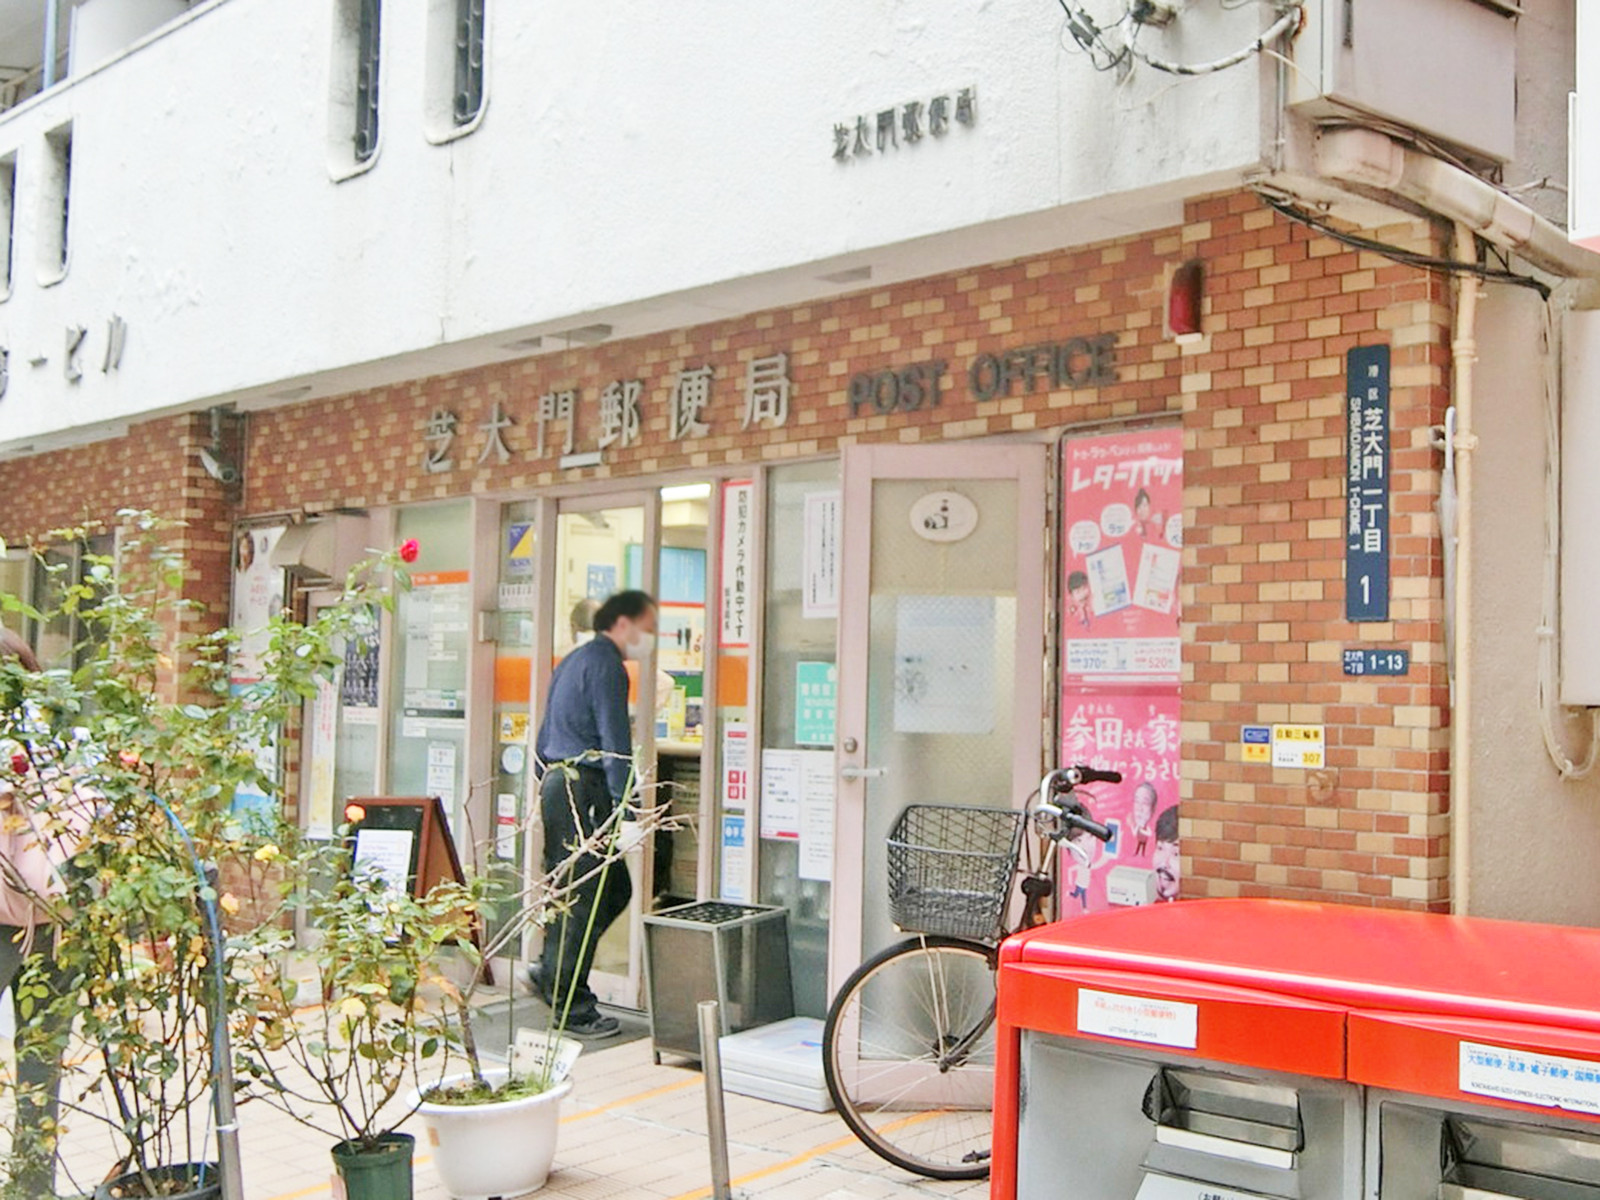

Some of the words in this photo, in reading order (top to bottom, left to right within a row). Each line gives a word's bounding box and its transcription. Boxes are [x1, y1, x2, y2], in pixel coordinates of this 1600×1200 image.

[848, 358, 948, 418] POST
[968, 332, 1120, 403] OFFICE
[423, 353, 793, 473] 芝大門郵便局
[1360, 575, 1370, 605] 1
[1370, 654, 1404, 670] 1-13
[1302, 752, 1322, 764] 307
